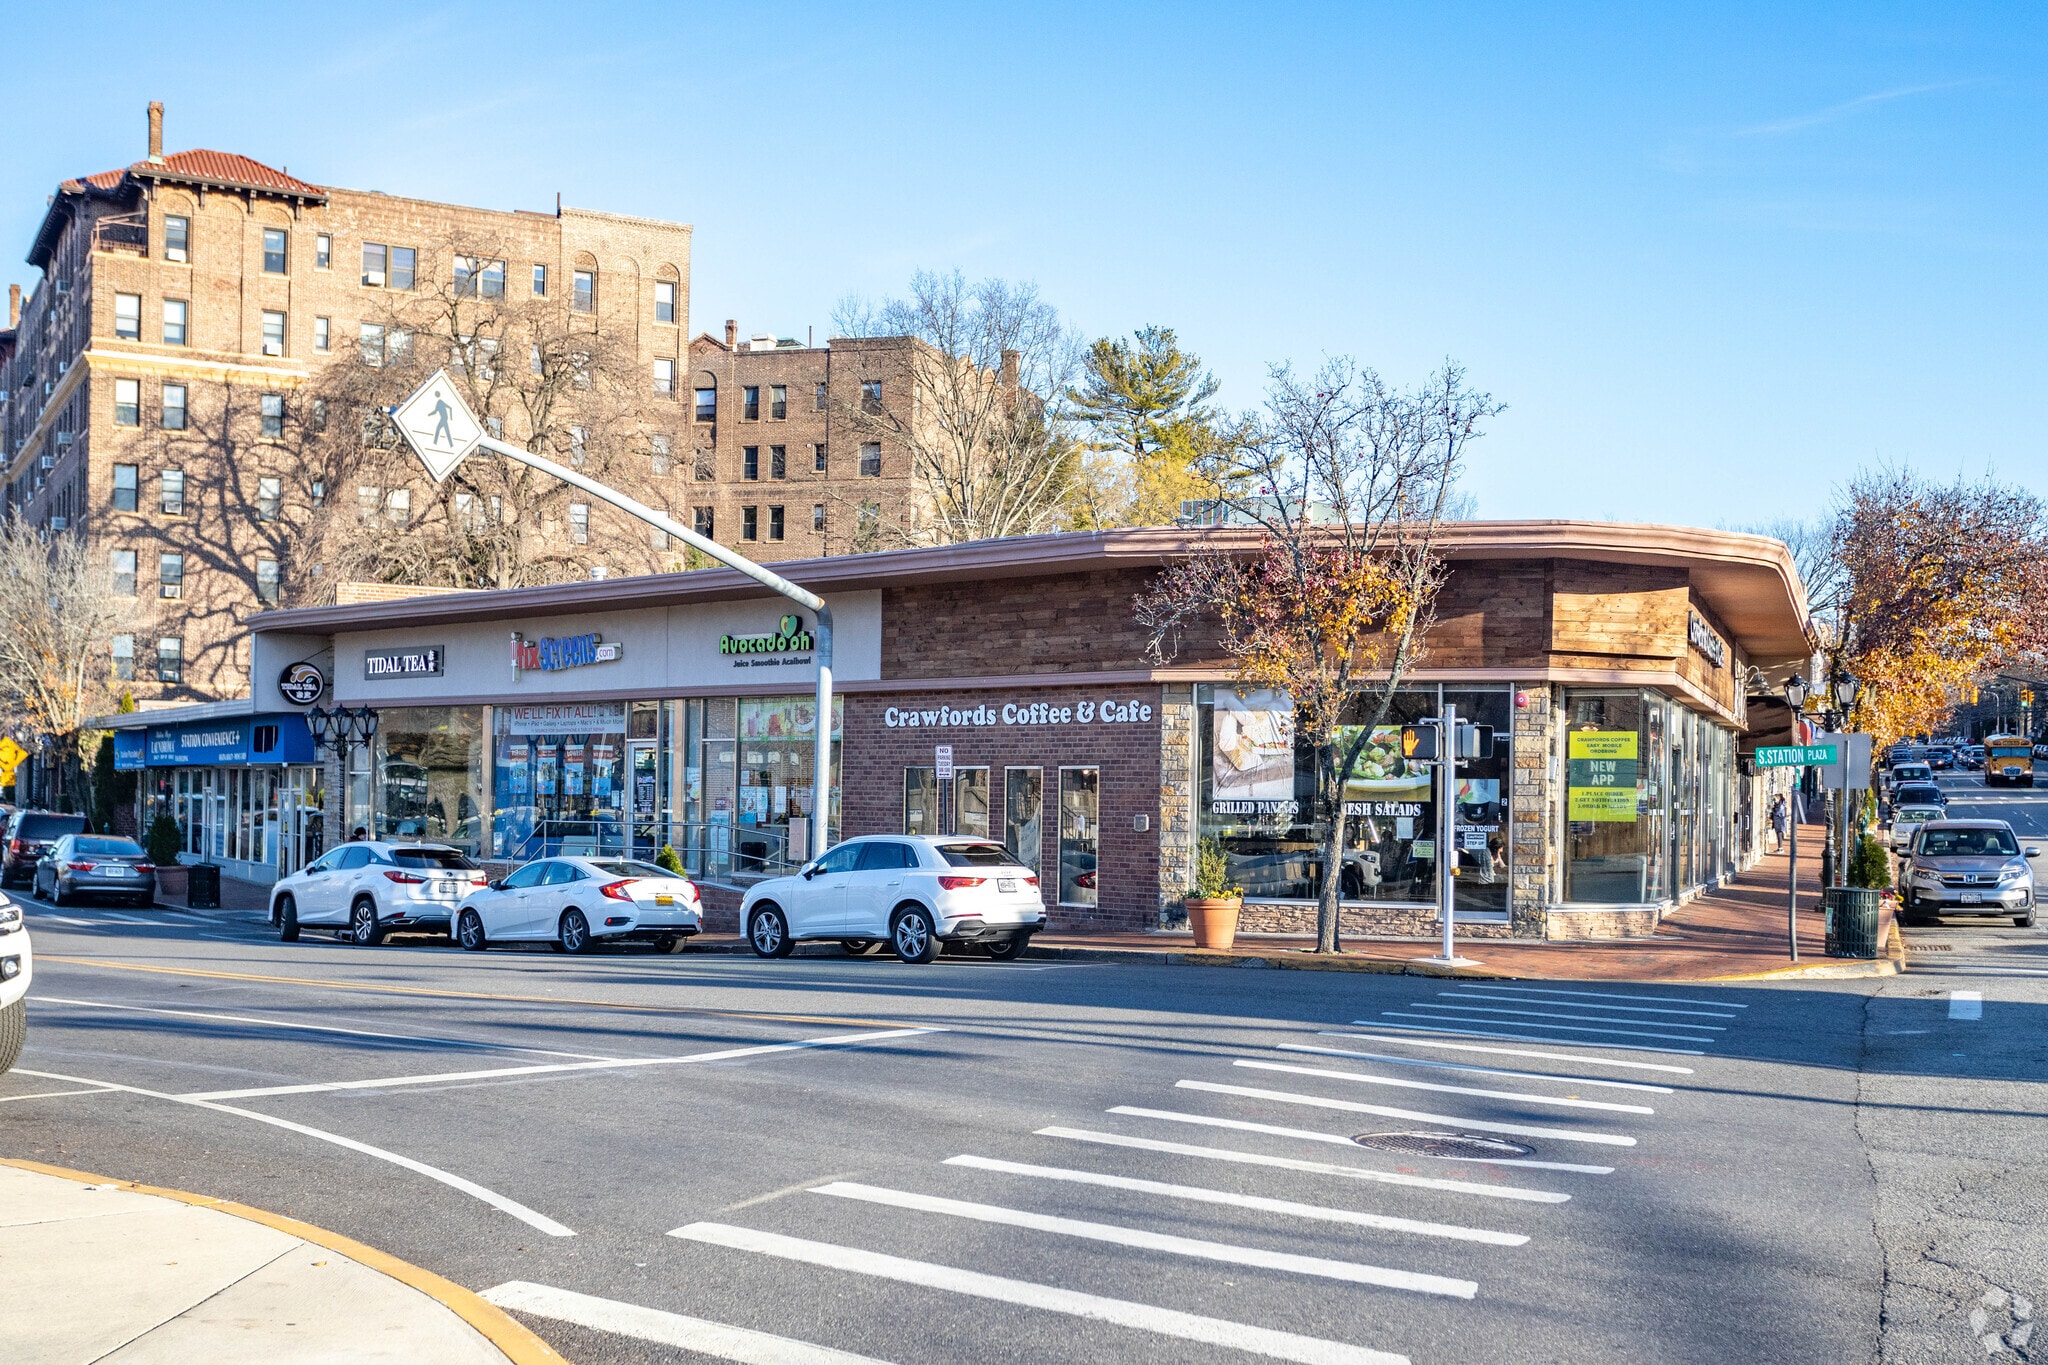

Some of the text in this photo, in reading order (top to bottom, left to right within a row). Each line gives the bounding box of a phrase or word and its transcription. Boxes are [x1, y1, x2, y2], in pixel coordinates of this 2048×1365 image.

[720, 632, 786, 654] Avocado
[367, 654, 427, 674] TIDAL TEA
[733, 659, 749, 668] Juice
[751, 658, 780, 667] Smoothie
[281, 683, 317, 691] TIDAL TEA
[514, 705, 597, 720] WE'LL FIX IT ALL!
[884, 700, 1152, 728] Crawfords Coffee & Cafe
[181, 733, 200, 748] STATION
[1758, 748, 1828, 764] S.STATION PLAZA
[1590, 760, 1616, 772] NEW
[1591, 774, 1615, 785] APP
[1212, 801, 1254, 814] GRILLED
[1345, 802, 1422, 817] ESH SALADS
